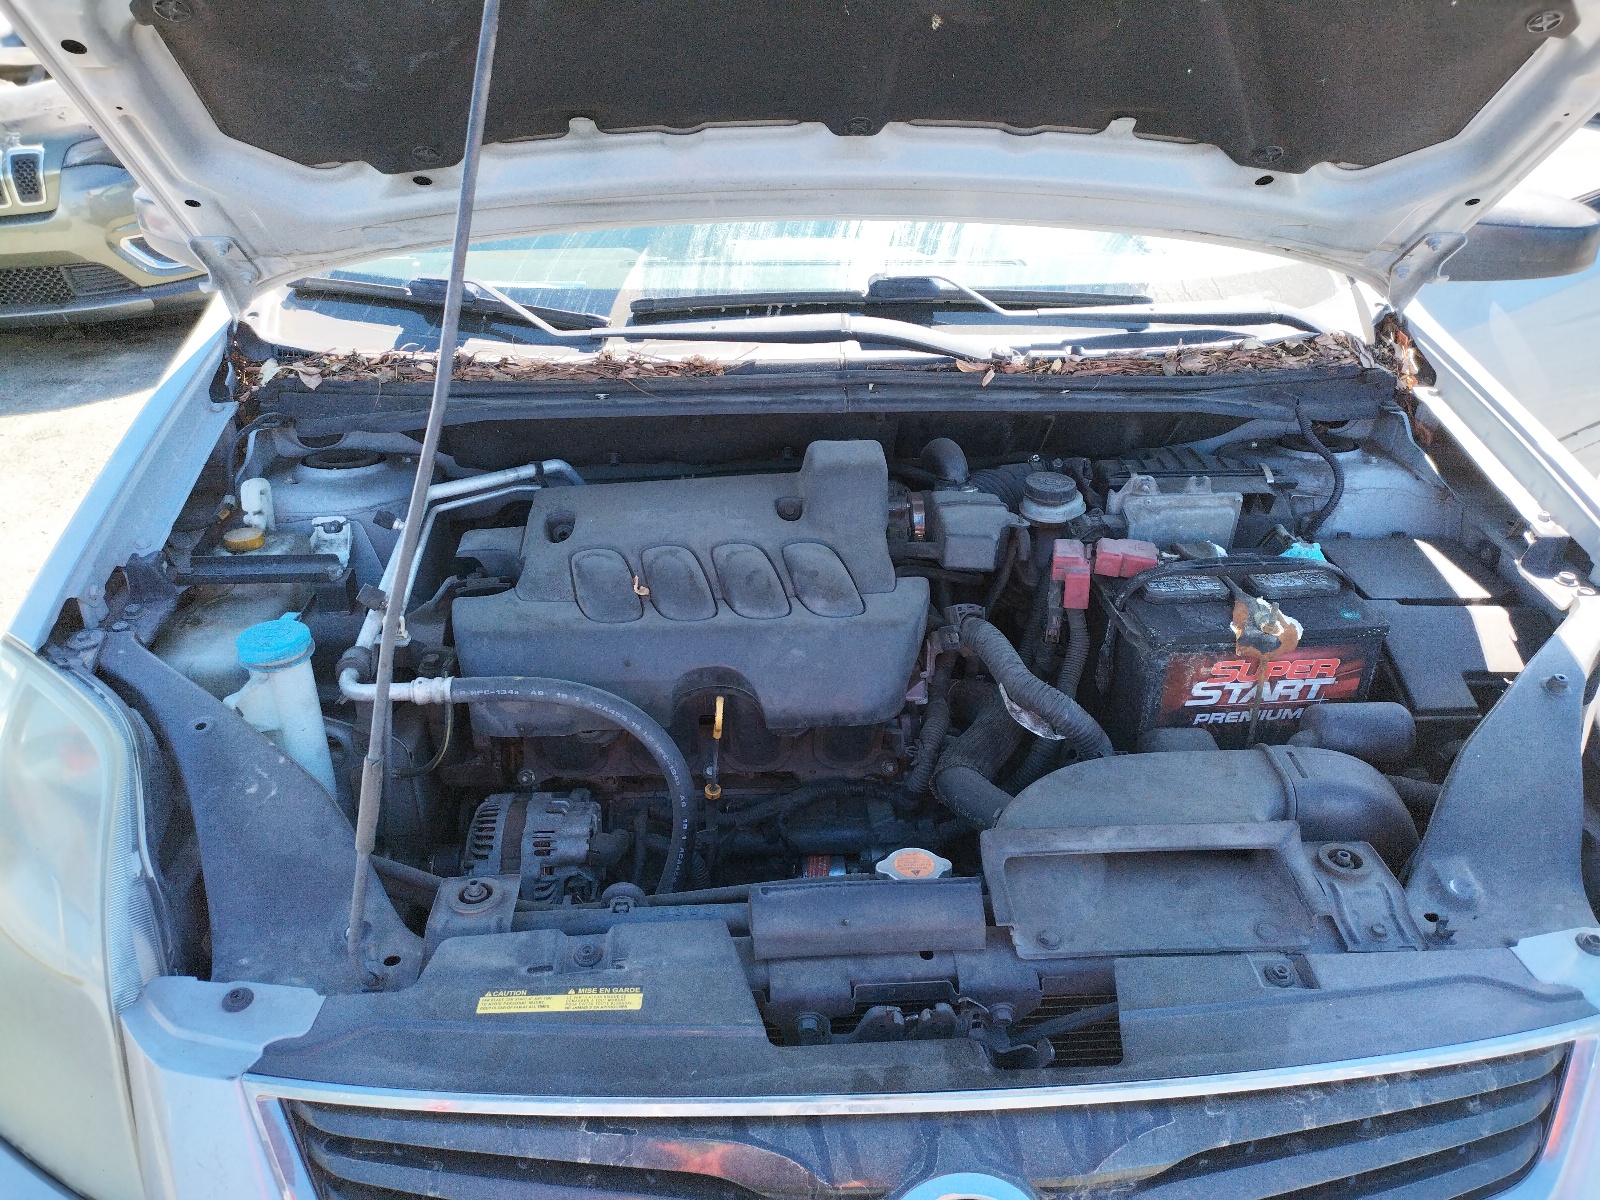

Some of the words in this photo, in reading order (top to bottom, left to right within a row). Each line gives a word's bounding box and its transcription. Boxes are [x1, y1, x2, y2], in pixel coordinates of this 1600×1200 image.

[1206, 658, 1341, 684] SUPER
[1185, 677, 1337, 707] START
[1193, 707, 1305, 726] PREMIUM
[492, 989, 528, 997] CAUTION
